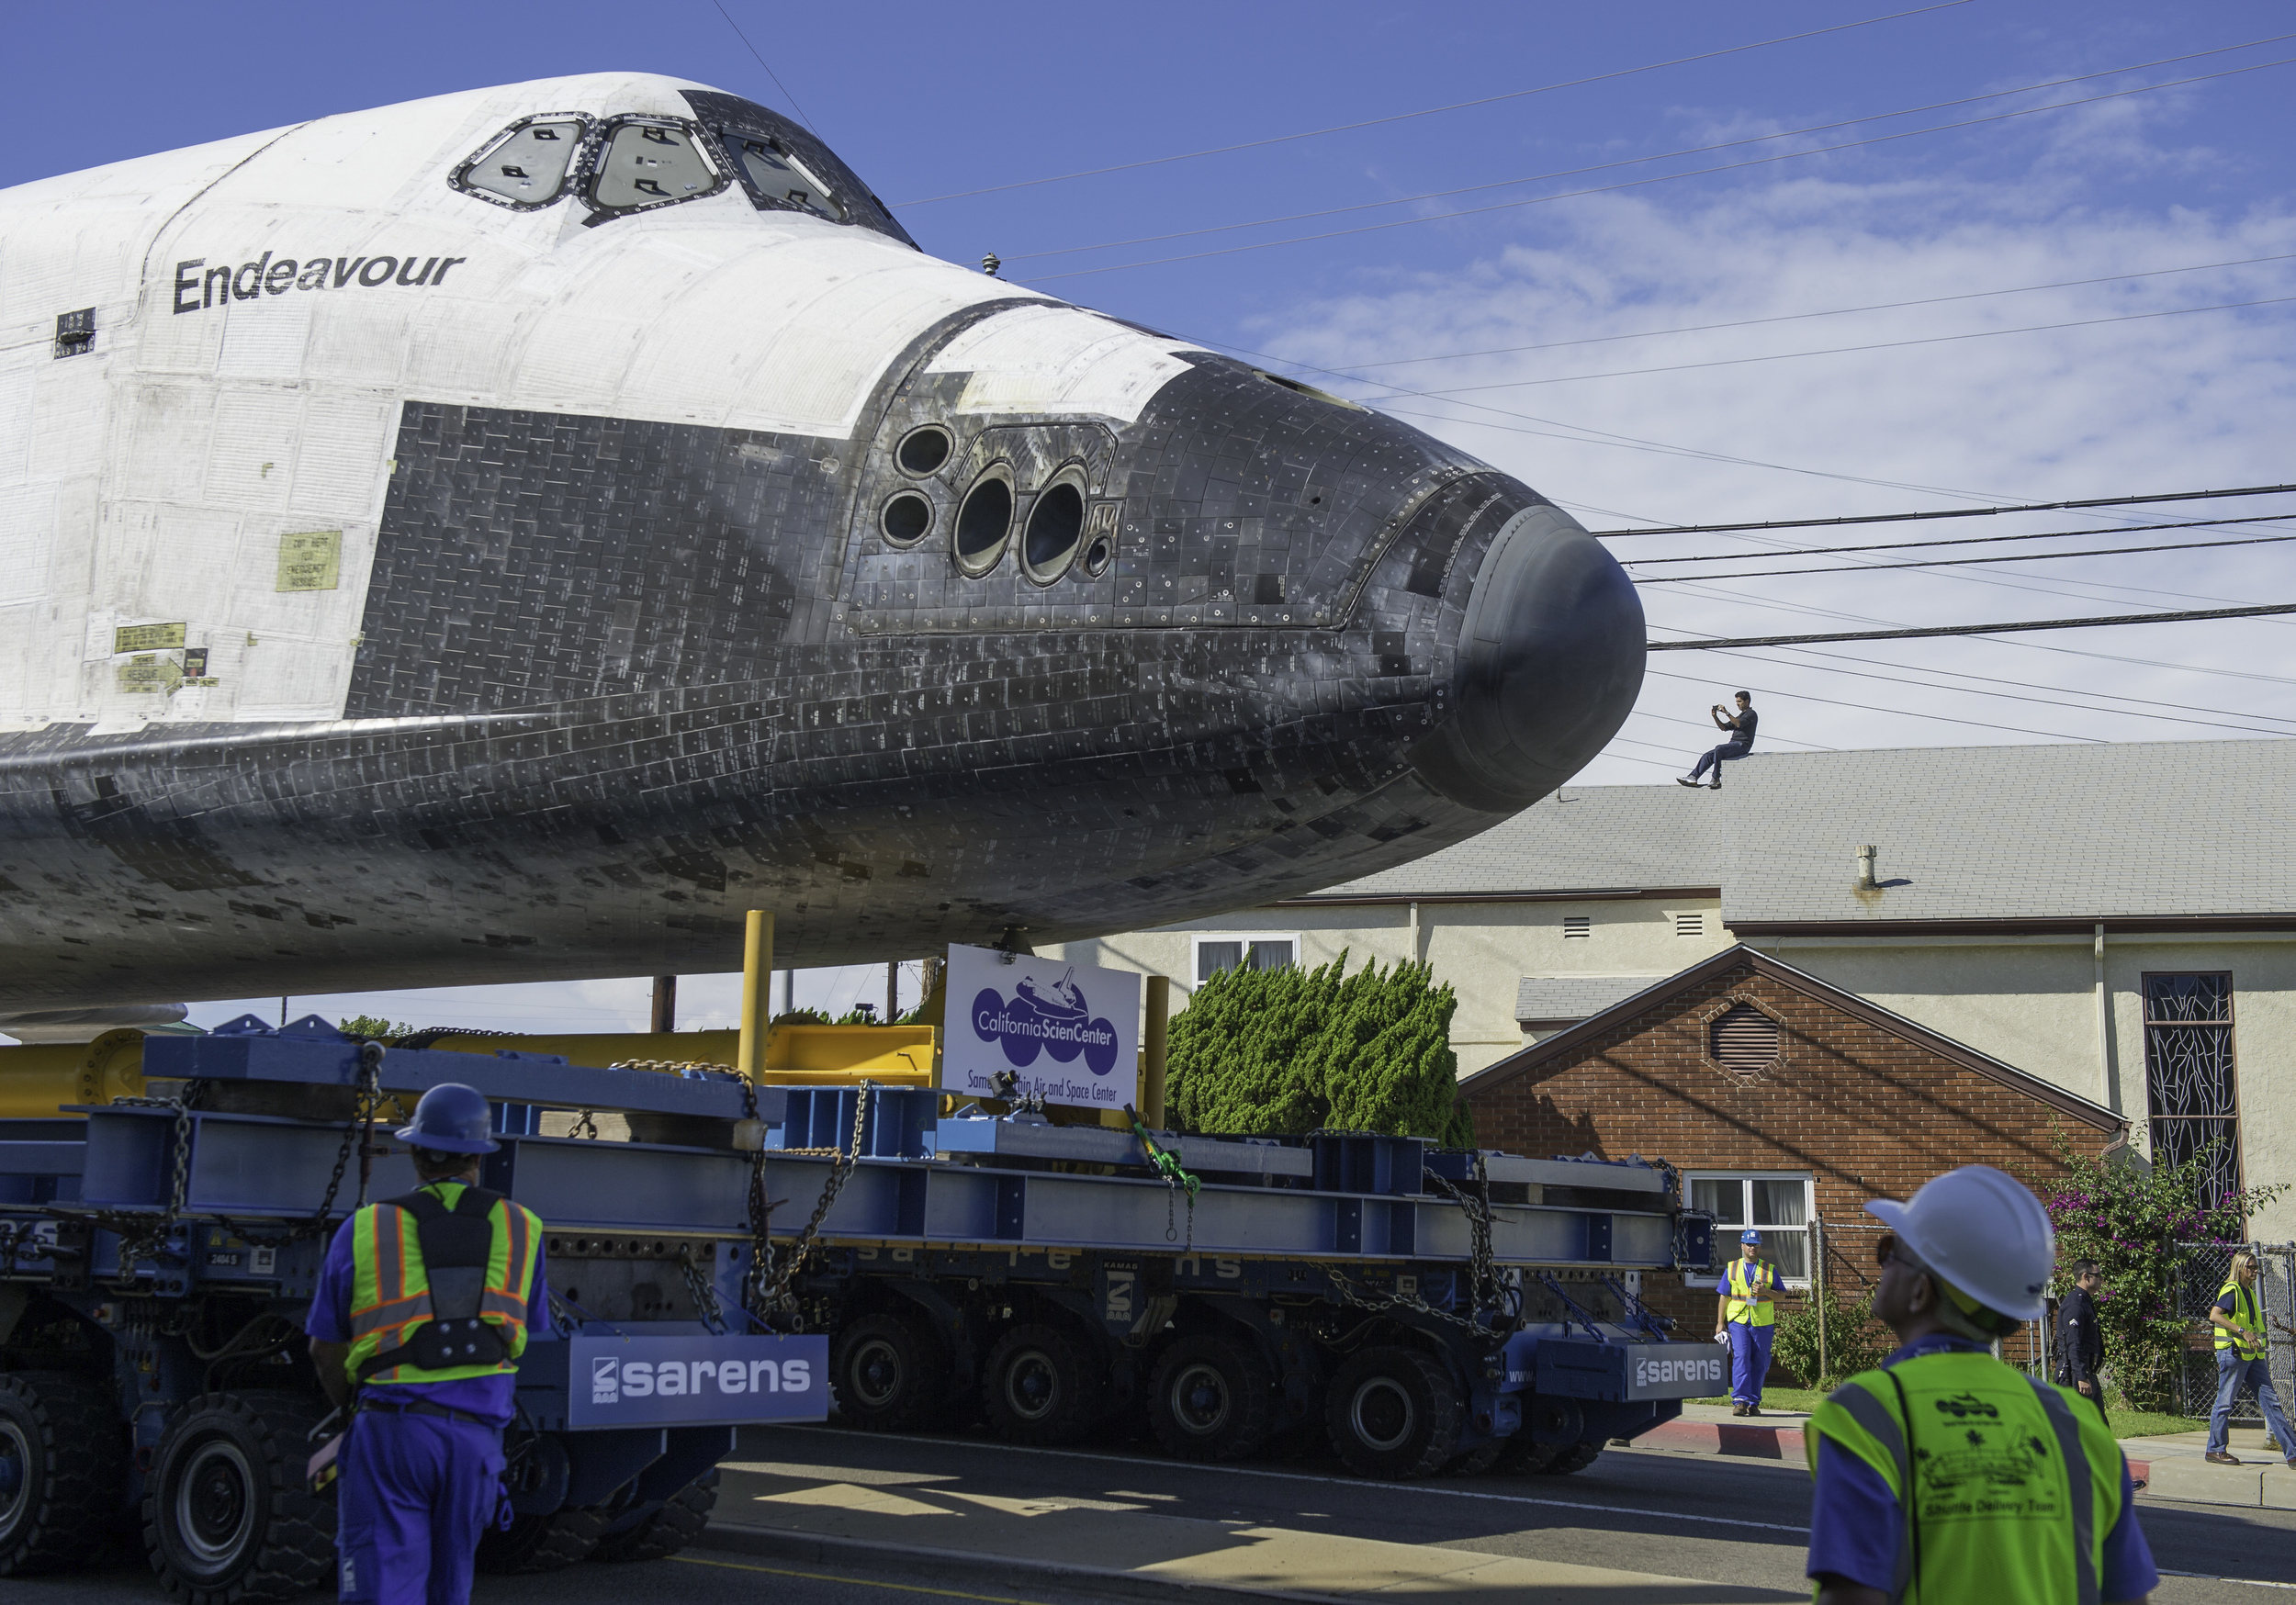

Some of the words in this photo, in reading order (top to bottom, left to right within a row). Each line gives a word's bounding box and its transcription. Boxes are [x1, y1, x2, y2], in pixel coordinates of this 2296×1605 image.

[173, 251, 467, 315] Endeavour
[1033, 1076, 1046, 1094] Air
[1048, 1077, 1064, 1096] and
[1066, 1080, 1089, 1102] Space
[1092, 1083, 1117, 1102] Center
[1103, 1261, 1139, 1270] KAMAG
[622, 1359, 811, 1397] sarens
[1647, 1359, 1721, 1383] sarens
